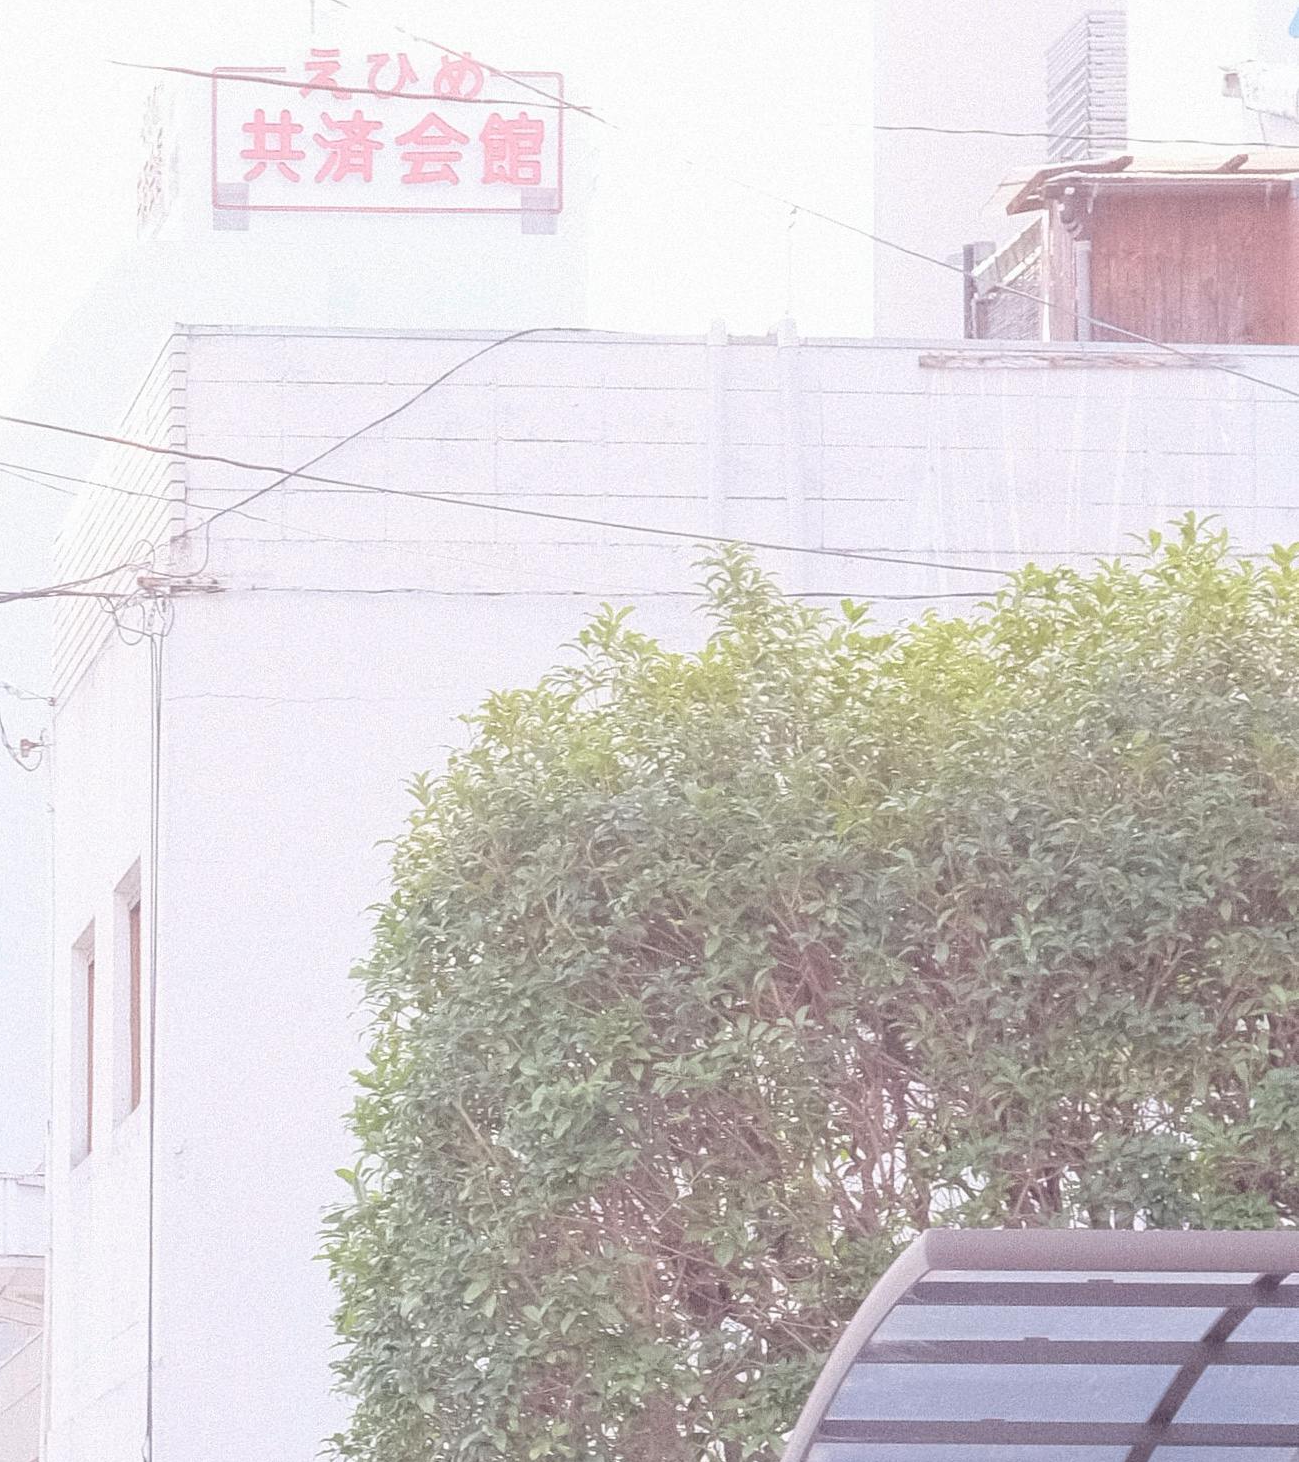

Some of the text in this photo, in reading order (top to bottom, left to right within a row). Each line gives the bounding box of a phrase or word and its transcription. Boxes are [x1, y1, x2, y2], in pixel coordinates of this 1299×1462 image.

[299, 46, 486, 102] えひめ
[239, 107, 547, 187] 共済会館
